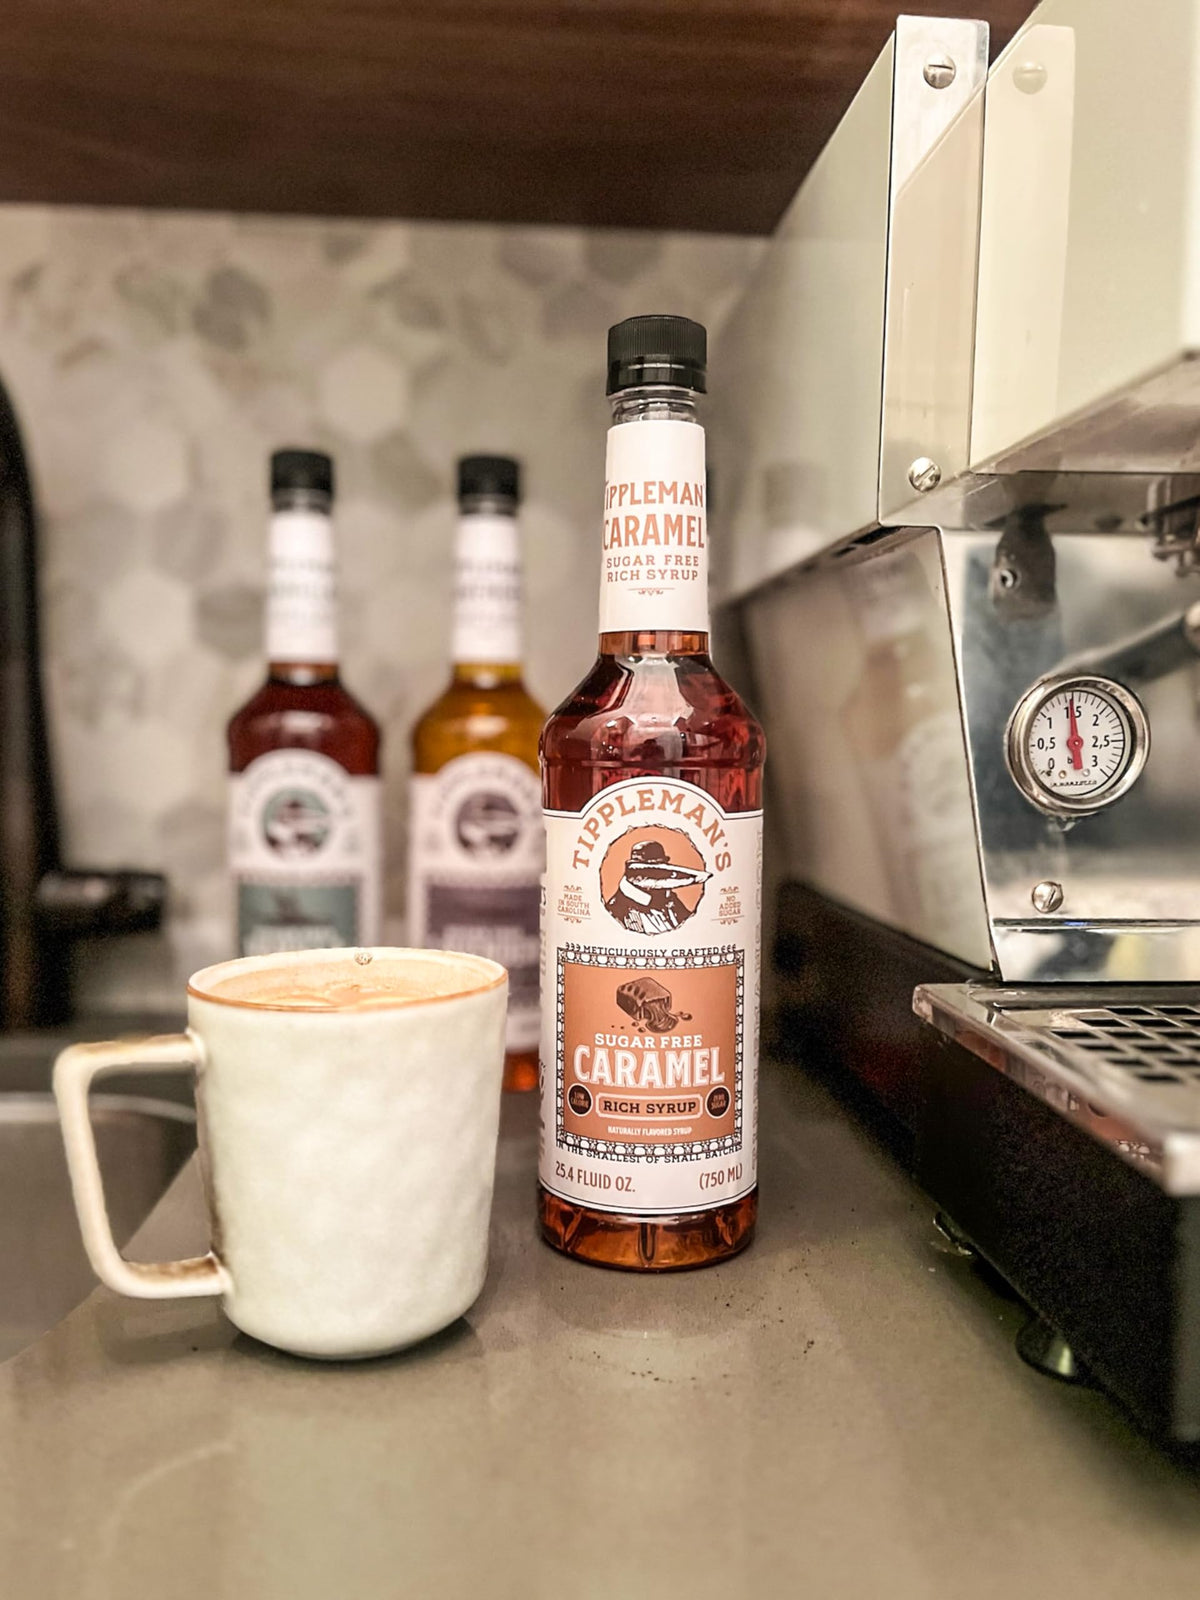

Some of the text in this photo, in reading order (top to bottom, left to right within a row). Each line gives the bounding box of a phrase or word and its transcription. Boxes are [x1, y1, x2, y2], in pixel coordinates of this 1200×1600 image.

[604, 481, 704, 510] IPPLEMAN
[603, 513, 705, 550] CARAMEL
[606, 555, 699, 569] SUGAR FREE
[607, 569, 698, 582] RICH SYRUP
[1047, 717, 1052, 729] 1
[1092, 714, 1099, 726] 2
[1037, 737, 1056, 752] 0,5
[1091, 735, 1110, 750] 2,5
[1048, 757, 1055, 770] 0
[1091, 755, 1098, 767] 3
[572, 788, 732, 873] TIPPLEMAN'S
[563, 893, 582, 901] MADE
[583, 945, 719, 958] METICULOUSLY CRAFTED
[594, 1033, 703, 1049] SUGAR FREE
[573, 1044, 725, 1088] CARAMEL
[603, 1100, 640, 1114] RICH
[646, 1101, 697, 1114] SYRUP
[567, 1145, 584, 1156] THE
[586, 1150, 640, 1163] SMALLEST
[646, 1155, 661, 1164] OF
[664, 1152, 701, 1164] SMALL
[555, 1161, 636, 1193] 25.4 FLUID OZ.
[699, 1163, 743, 1190] (750 ML)
